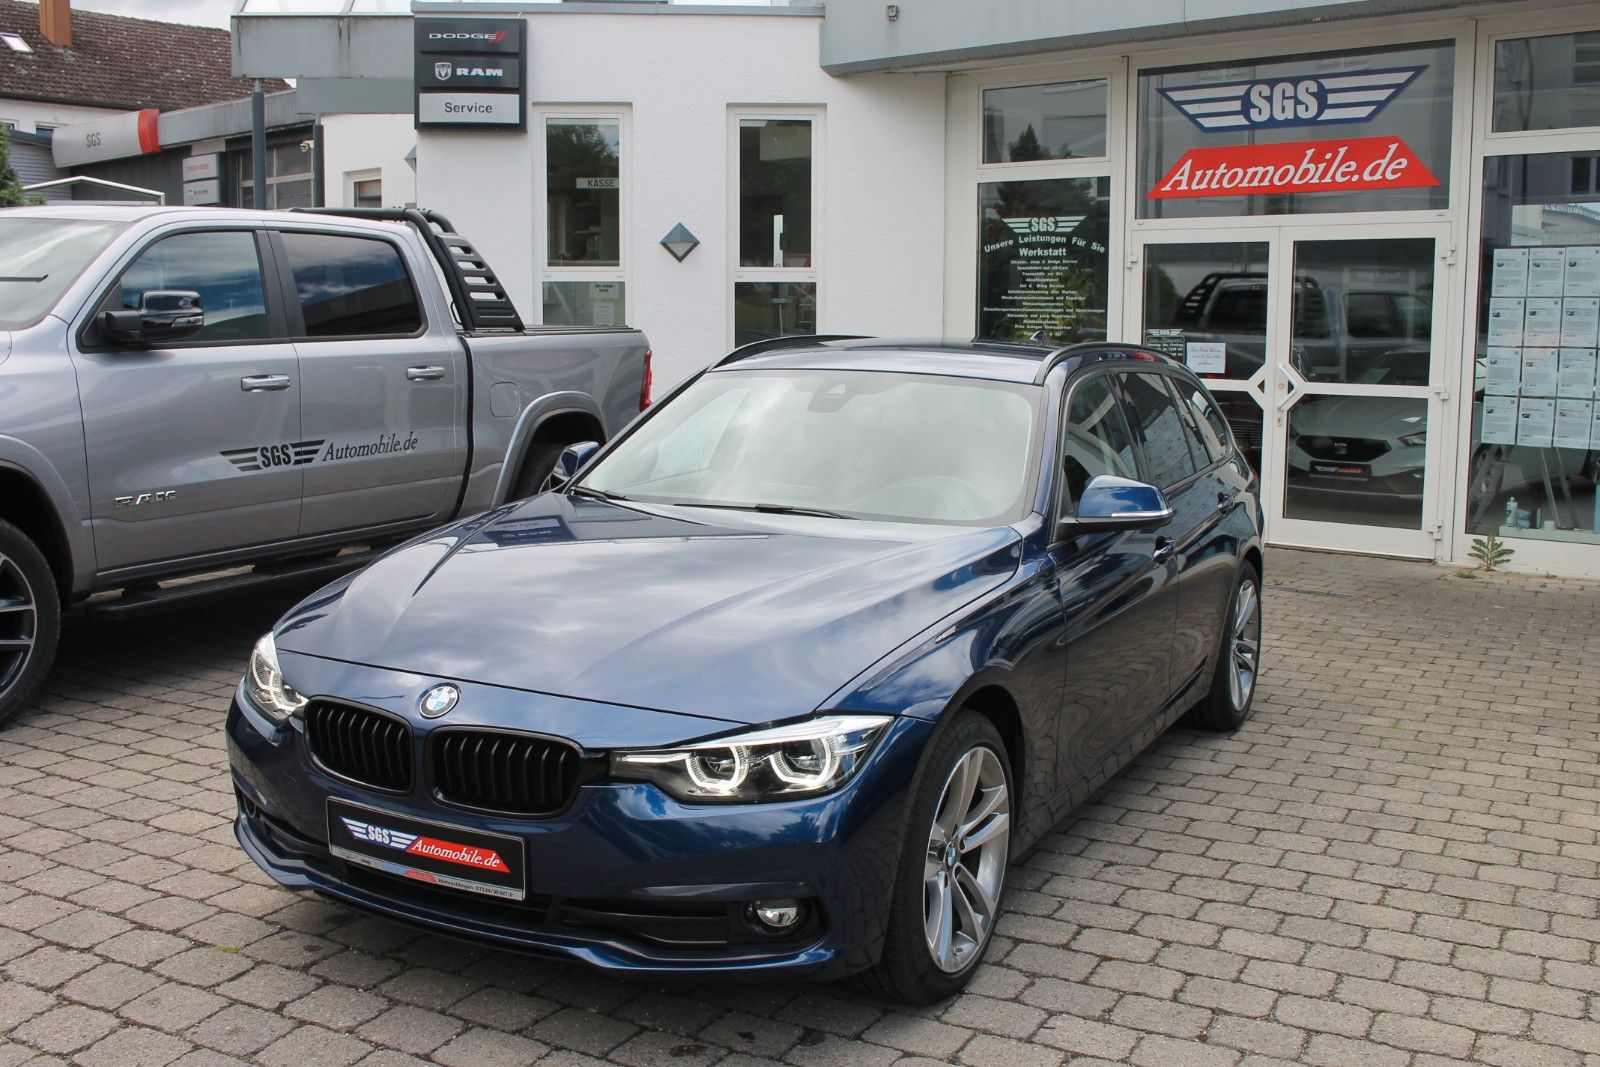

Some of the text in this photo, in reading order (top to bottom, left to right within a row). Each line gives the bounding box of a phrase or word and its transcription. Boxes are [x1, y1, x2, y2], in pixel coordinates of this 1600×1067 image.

[456, 68, 503, 76] RAM
[444, 102, 493, 113] Service
[1249, 80, 1318, 123] SGS
[86, 133, 101, 148] SGS
[1160, 143, 1408, 192] Automobile.de
[587, 178, 615, 188] KASSE
[1031, 217, 1055, 232] SGS
[983, 234, 1105, 254] Unsere Leistungen Für Sie
[1019, 247, 1067, 257] Werkstatt
[260, 431, 418, 469] SGS Automobile.de
[367, 825, 390, 844] SGS
[412, 839, 500, 868] Automobile.de
